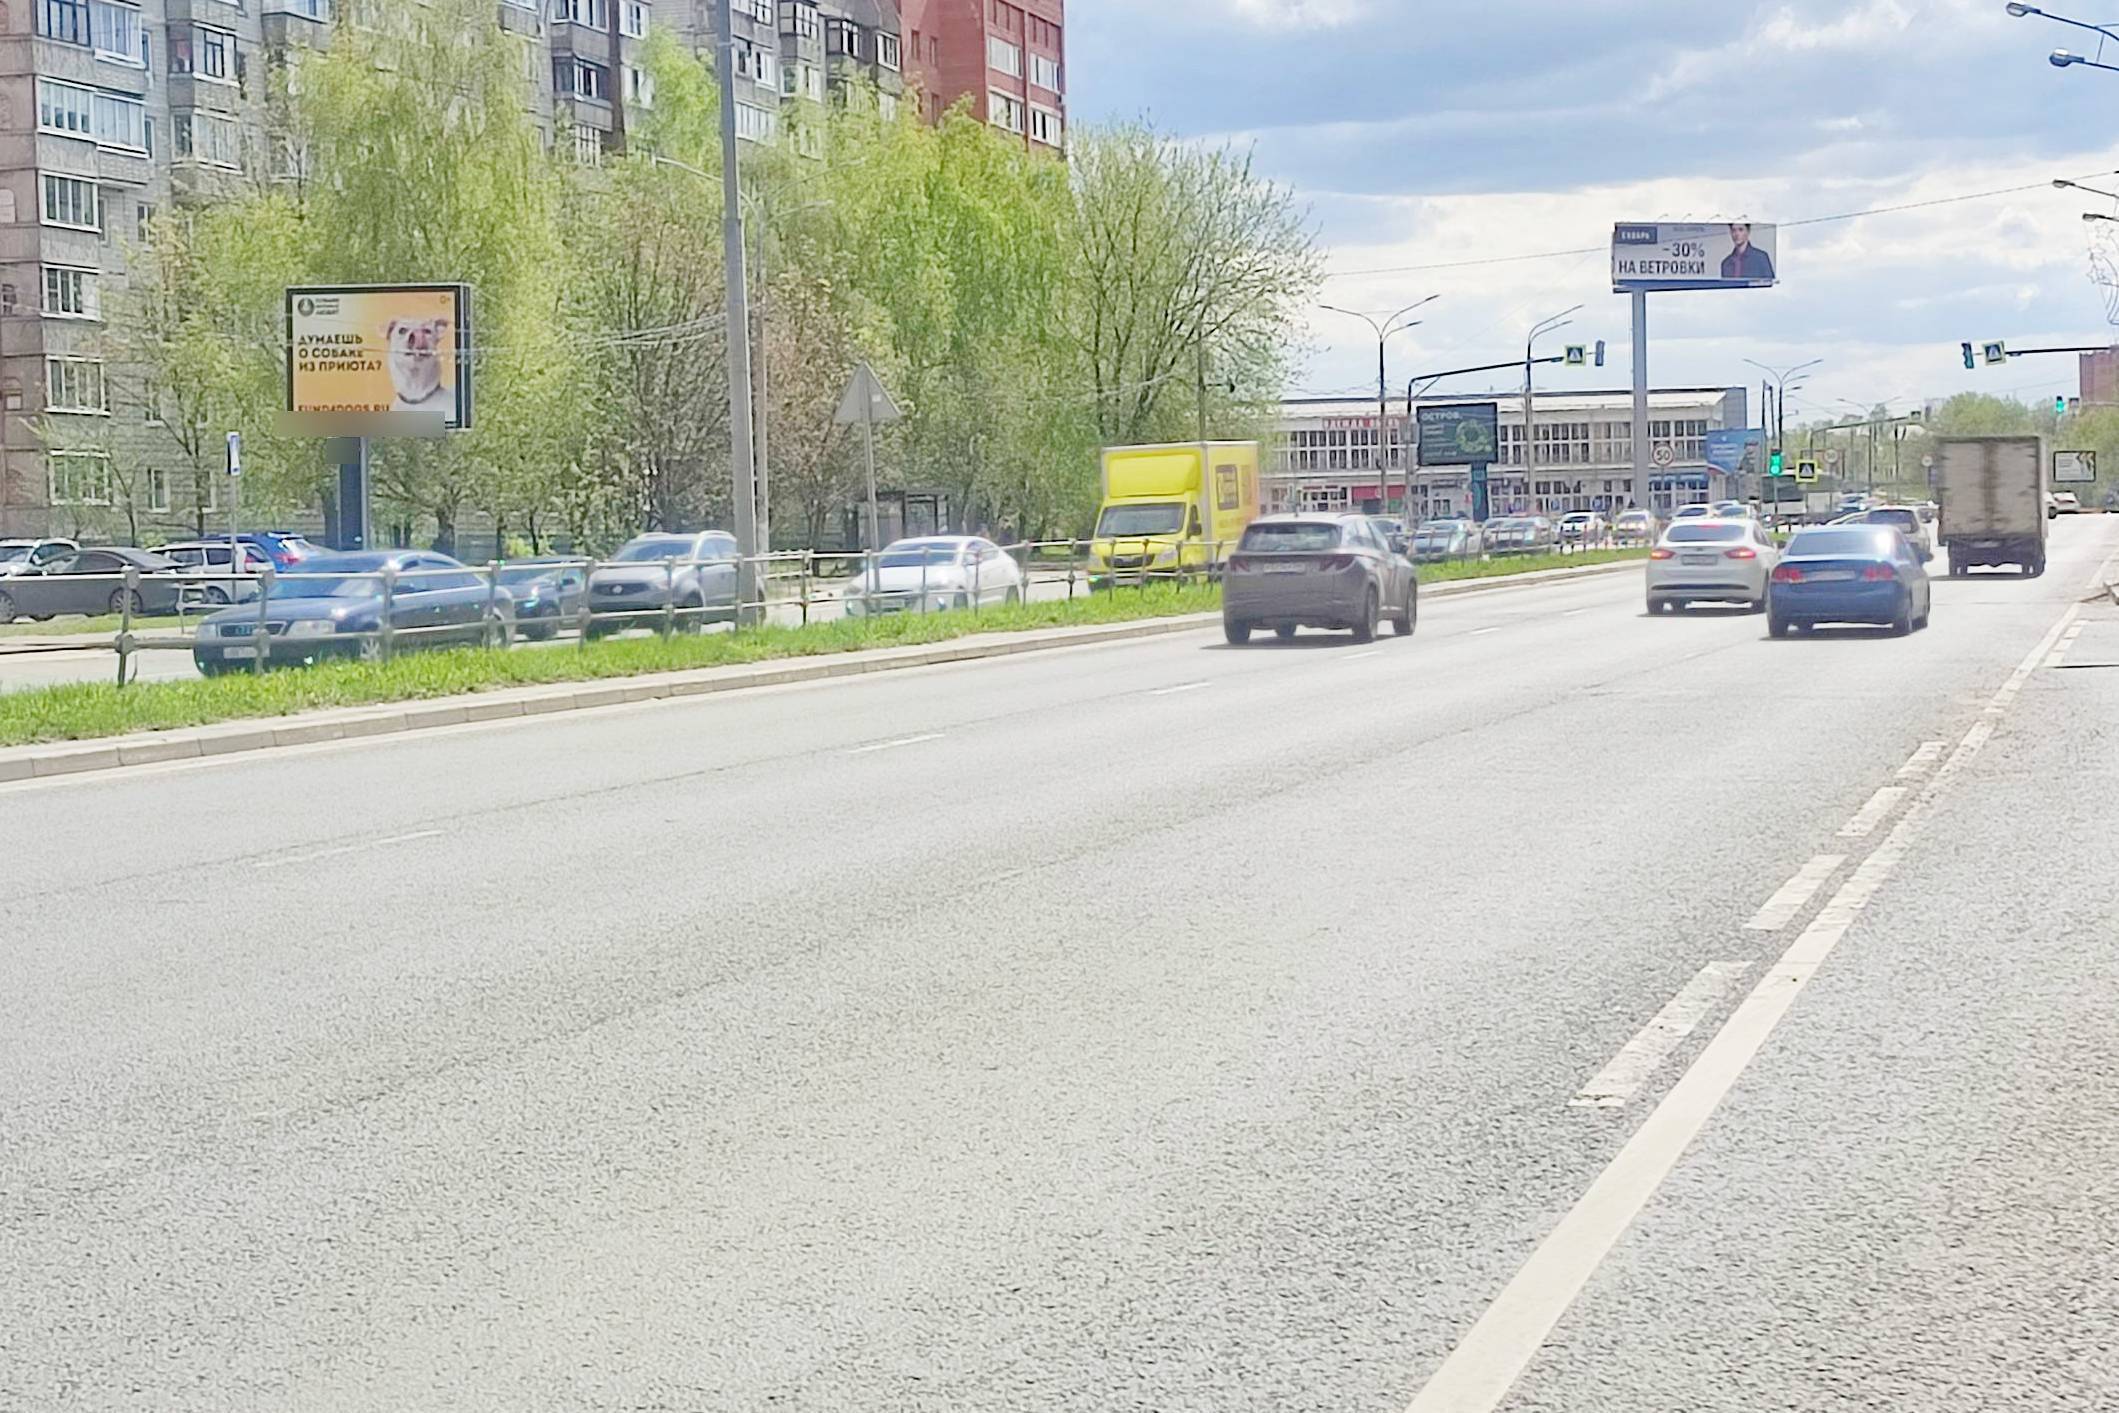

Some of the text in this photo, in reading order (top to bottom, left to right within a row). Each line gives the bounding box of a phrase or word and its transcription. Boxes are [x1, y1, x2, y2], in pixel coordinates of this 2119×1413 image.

[1618, 260, 1705, 274] НА ВЕТРОВКИ
[298, 334, 363, 345] ДУМАЕШЬ
[299, 347, 363, 358] О СОБАКЕ
[299, 361, 382, 372] ИЗ ПРИЮТА?
[1656, 449, 1671, 461] 50
